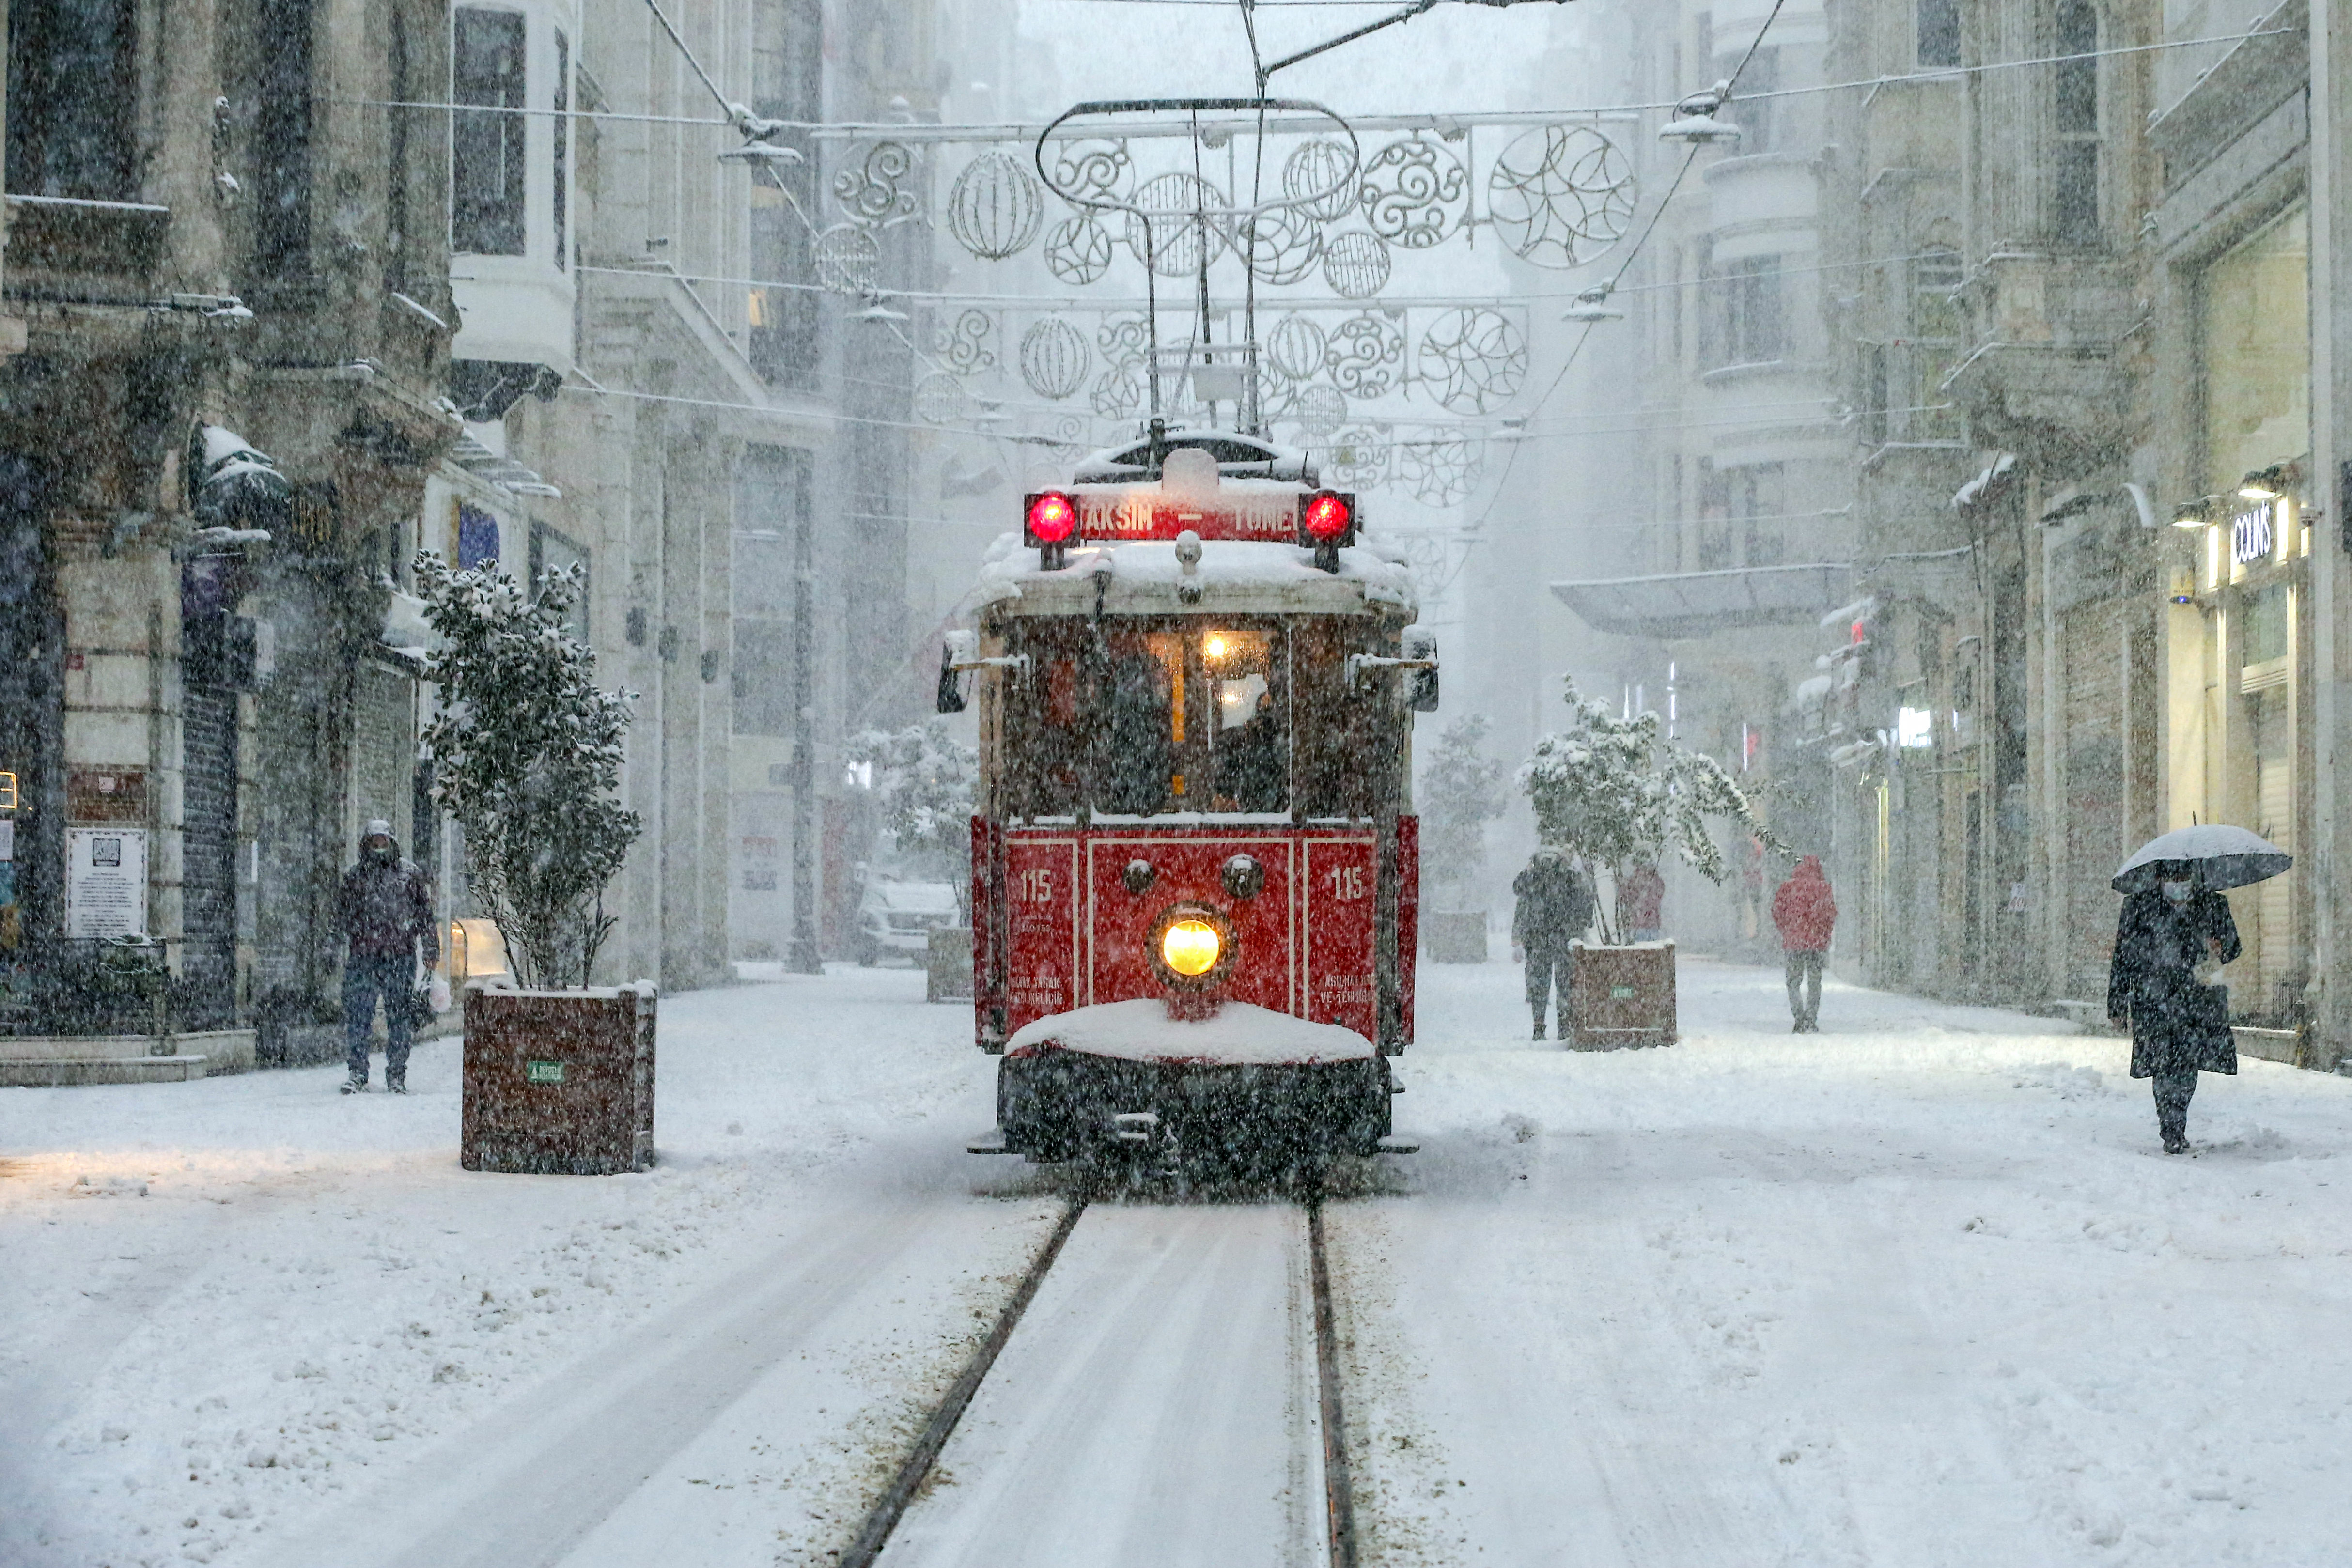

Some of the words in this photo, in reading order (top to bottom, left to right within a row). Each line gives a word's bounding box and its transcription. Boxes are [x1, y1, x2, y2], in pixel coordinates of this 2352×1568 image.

[2234, 500, 2271, 565] COLIN'S
[1020, 869, 1051, 902] 115
[1331, 866, 1363, 900] 115
